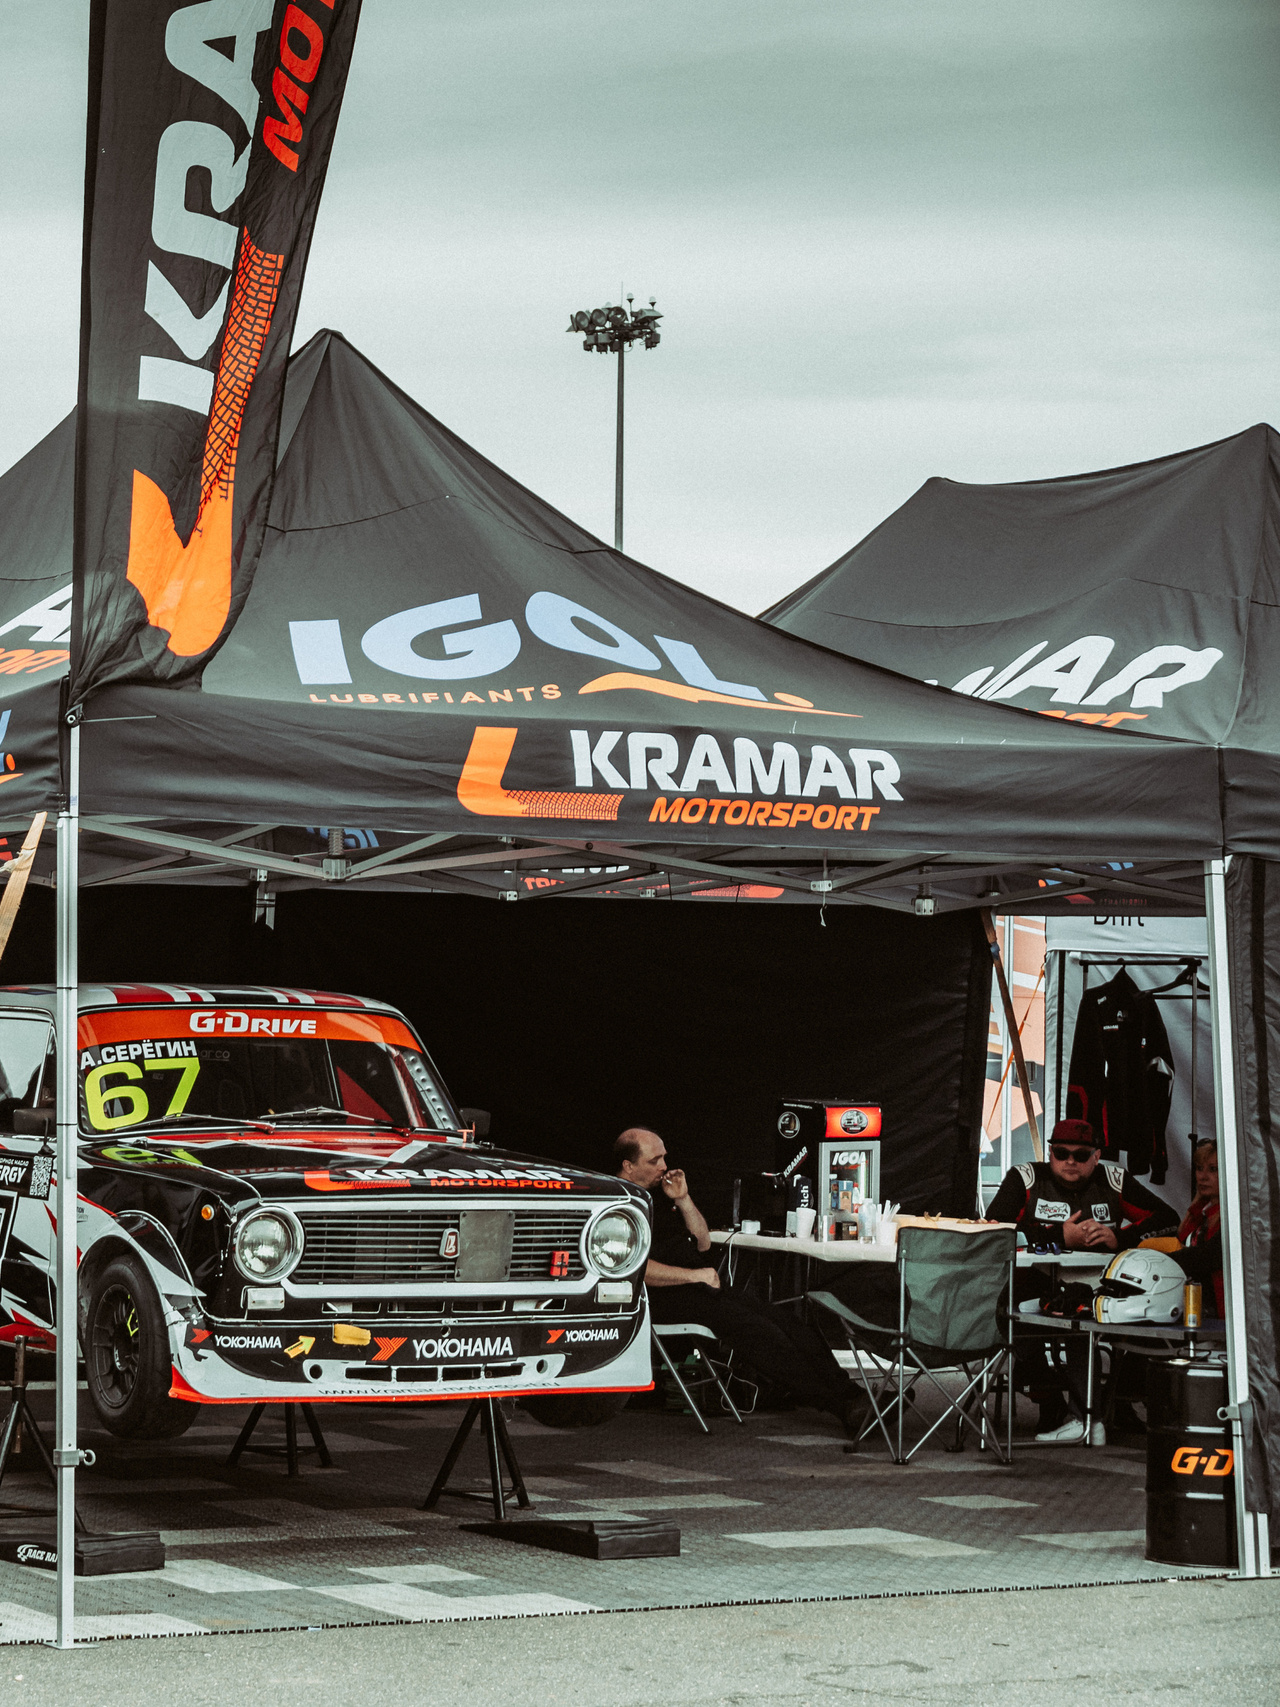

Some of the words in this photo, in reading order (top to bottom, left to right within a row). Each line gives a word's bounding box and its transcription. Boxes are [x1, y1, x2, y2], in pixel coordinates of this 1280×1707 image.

[309, 683, 562, 704] LUBRIFIANTS
[570, 730, 904, 801] KRAMAR
[648, 797, 880, 832] MOTORSPORT
[84, 1057, 201, 1131] 67
[345, 1169, 571, 1181] KRAMAR
[430, 1178, 574, 1190] MOTORSPORT
[214, 1334, 282, 1349] YOKOHAMA
[565, 1328, 619, 1343] YOKOHAMA
[413, 1336, 514, 1359] YOKOHAMA
